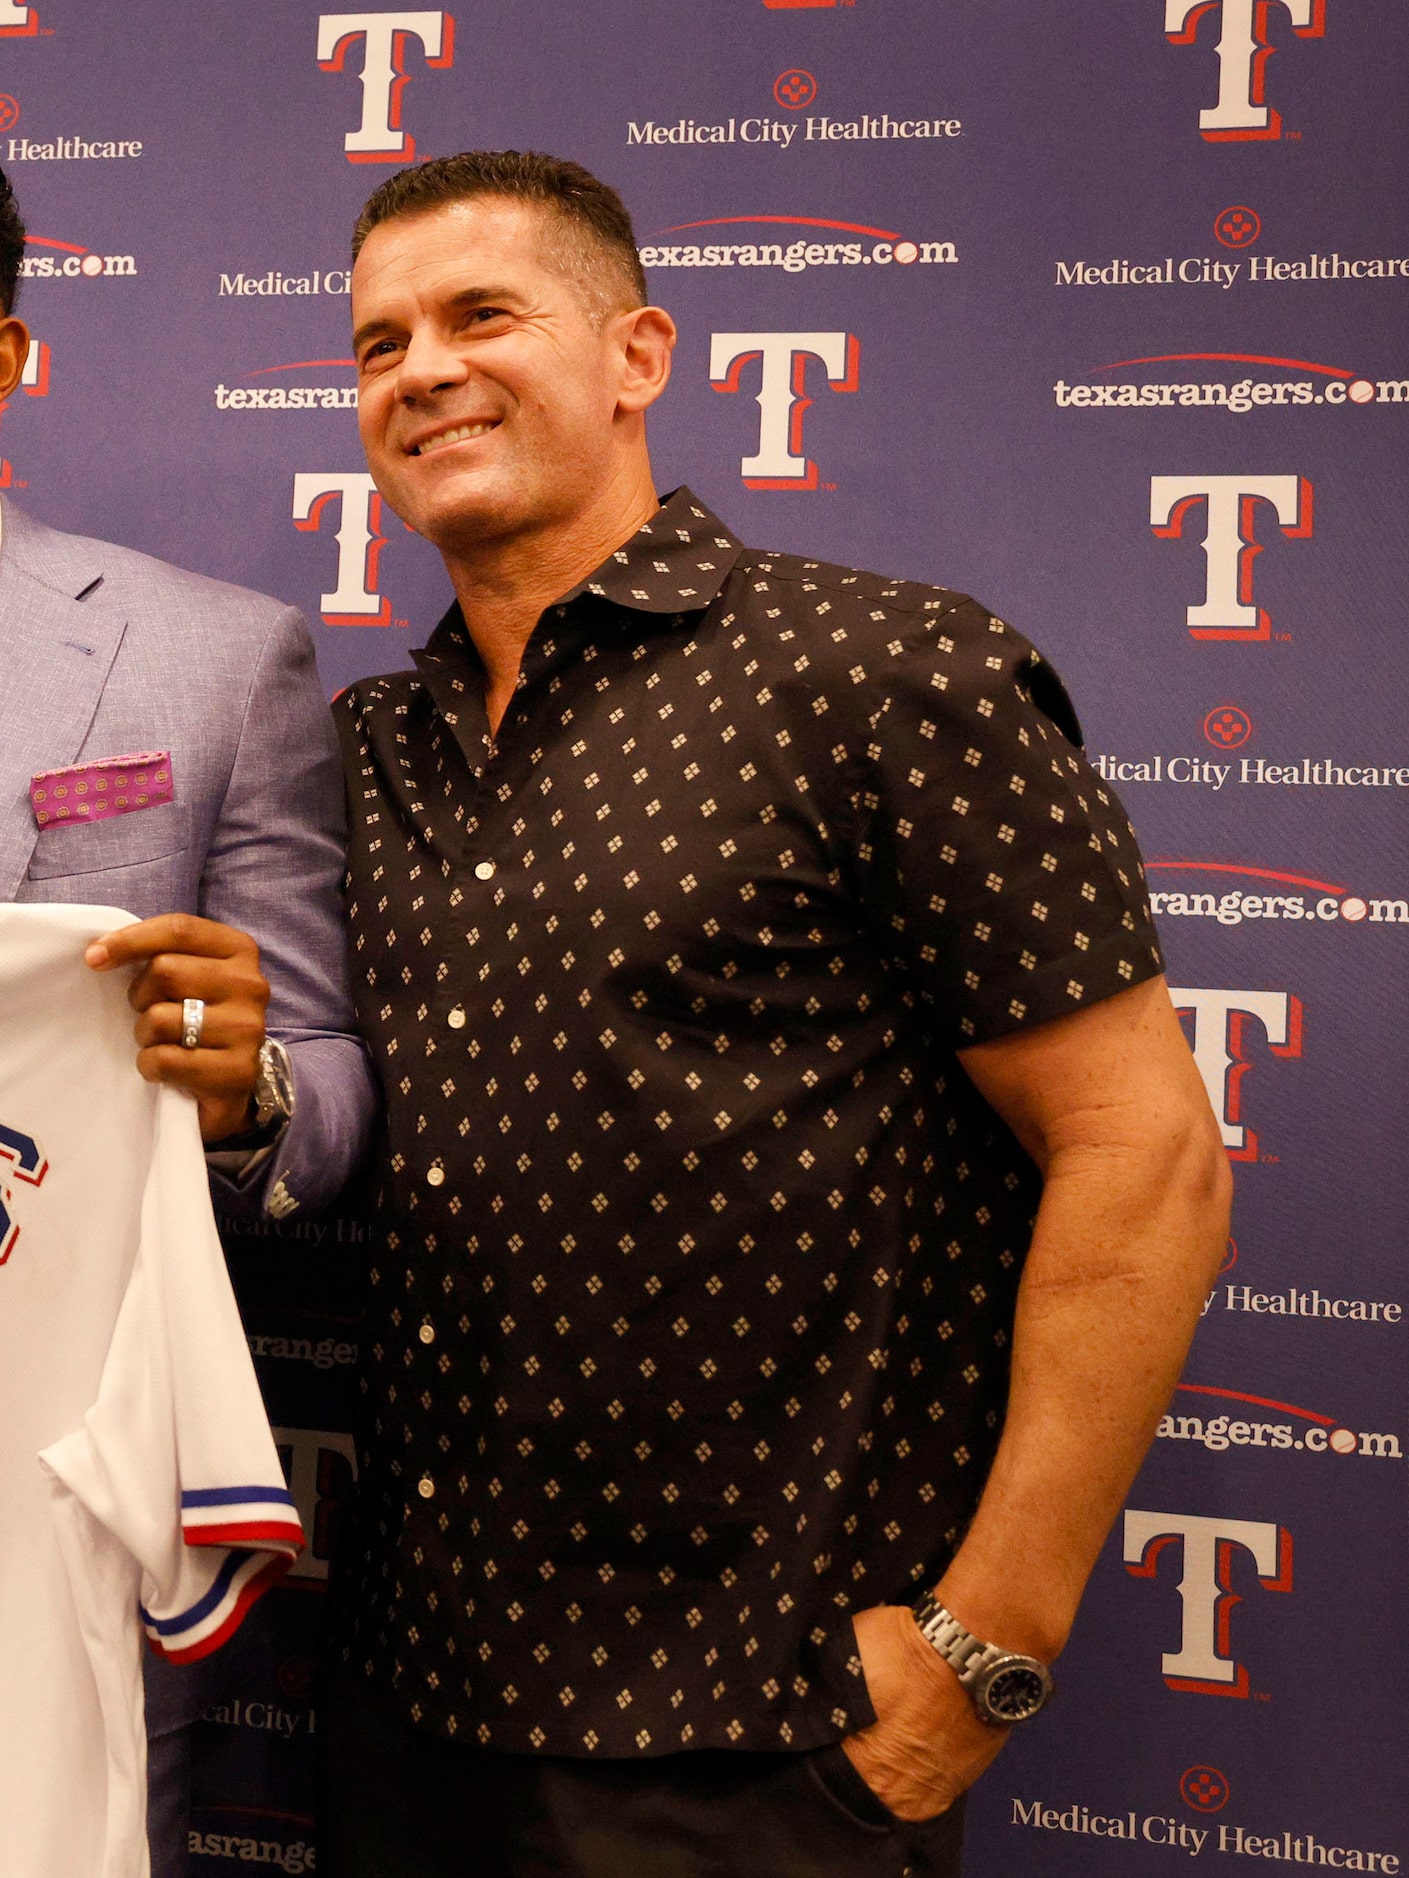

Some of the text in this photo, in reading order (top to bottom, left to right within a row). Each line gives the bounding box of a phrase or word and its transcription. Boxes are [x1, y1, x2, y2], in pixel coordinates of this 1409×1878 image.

[315, 11, 455, 164] T
[6, 136, 143, 161] Healthcare
[626, 114, 962, 148] Medical City Healthcare
[638, 240, 958, 273] exasrangers.com
[1055, 259, 1174, 286] Medical
[1178, 258, 1240, 289] City
[218, 271, 319, 296] Medical
[709, 332, 860, 491] T
[1149, 475, 1314, 641] T
[1166, 757, 1231, 791] City
[1238, 758, 1409, 787] Healthcare
[1224, 1285, 1402, 1323] Healthcare
[1123, 1509, 1293, 1699] T
[244, 1702, 301, 1740] City
[1010, 1797, 1400, 1876] Medical City Healthcare
